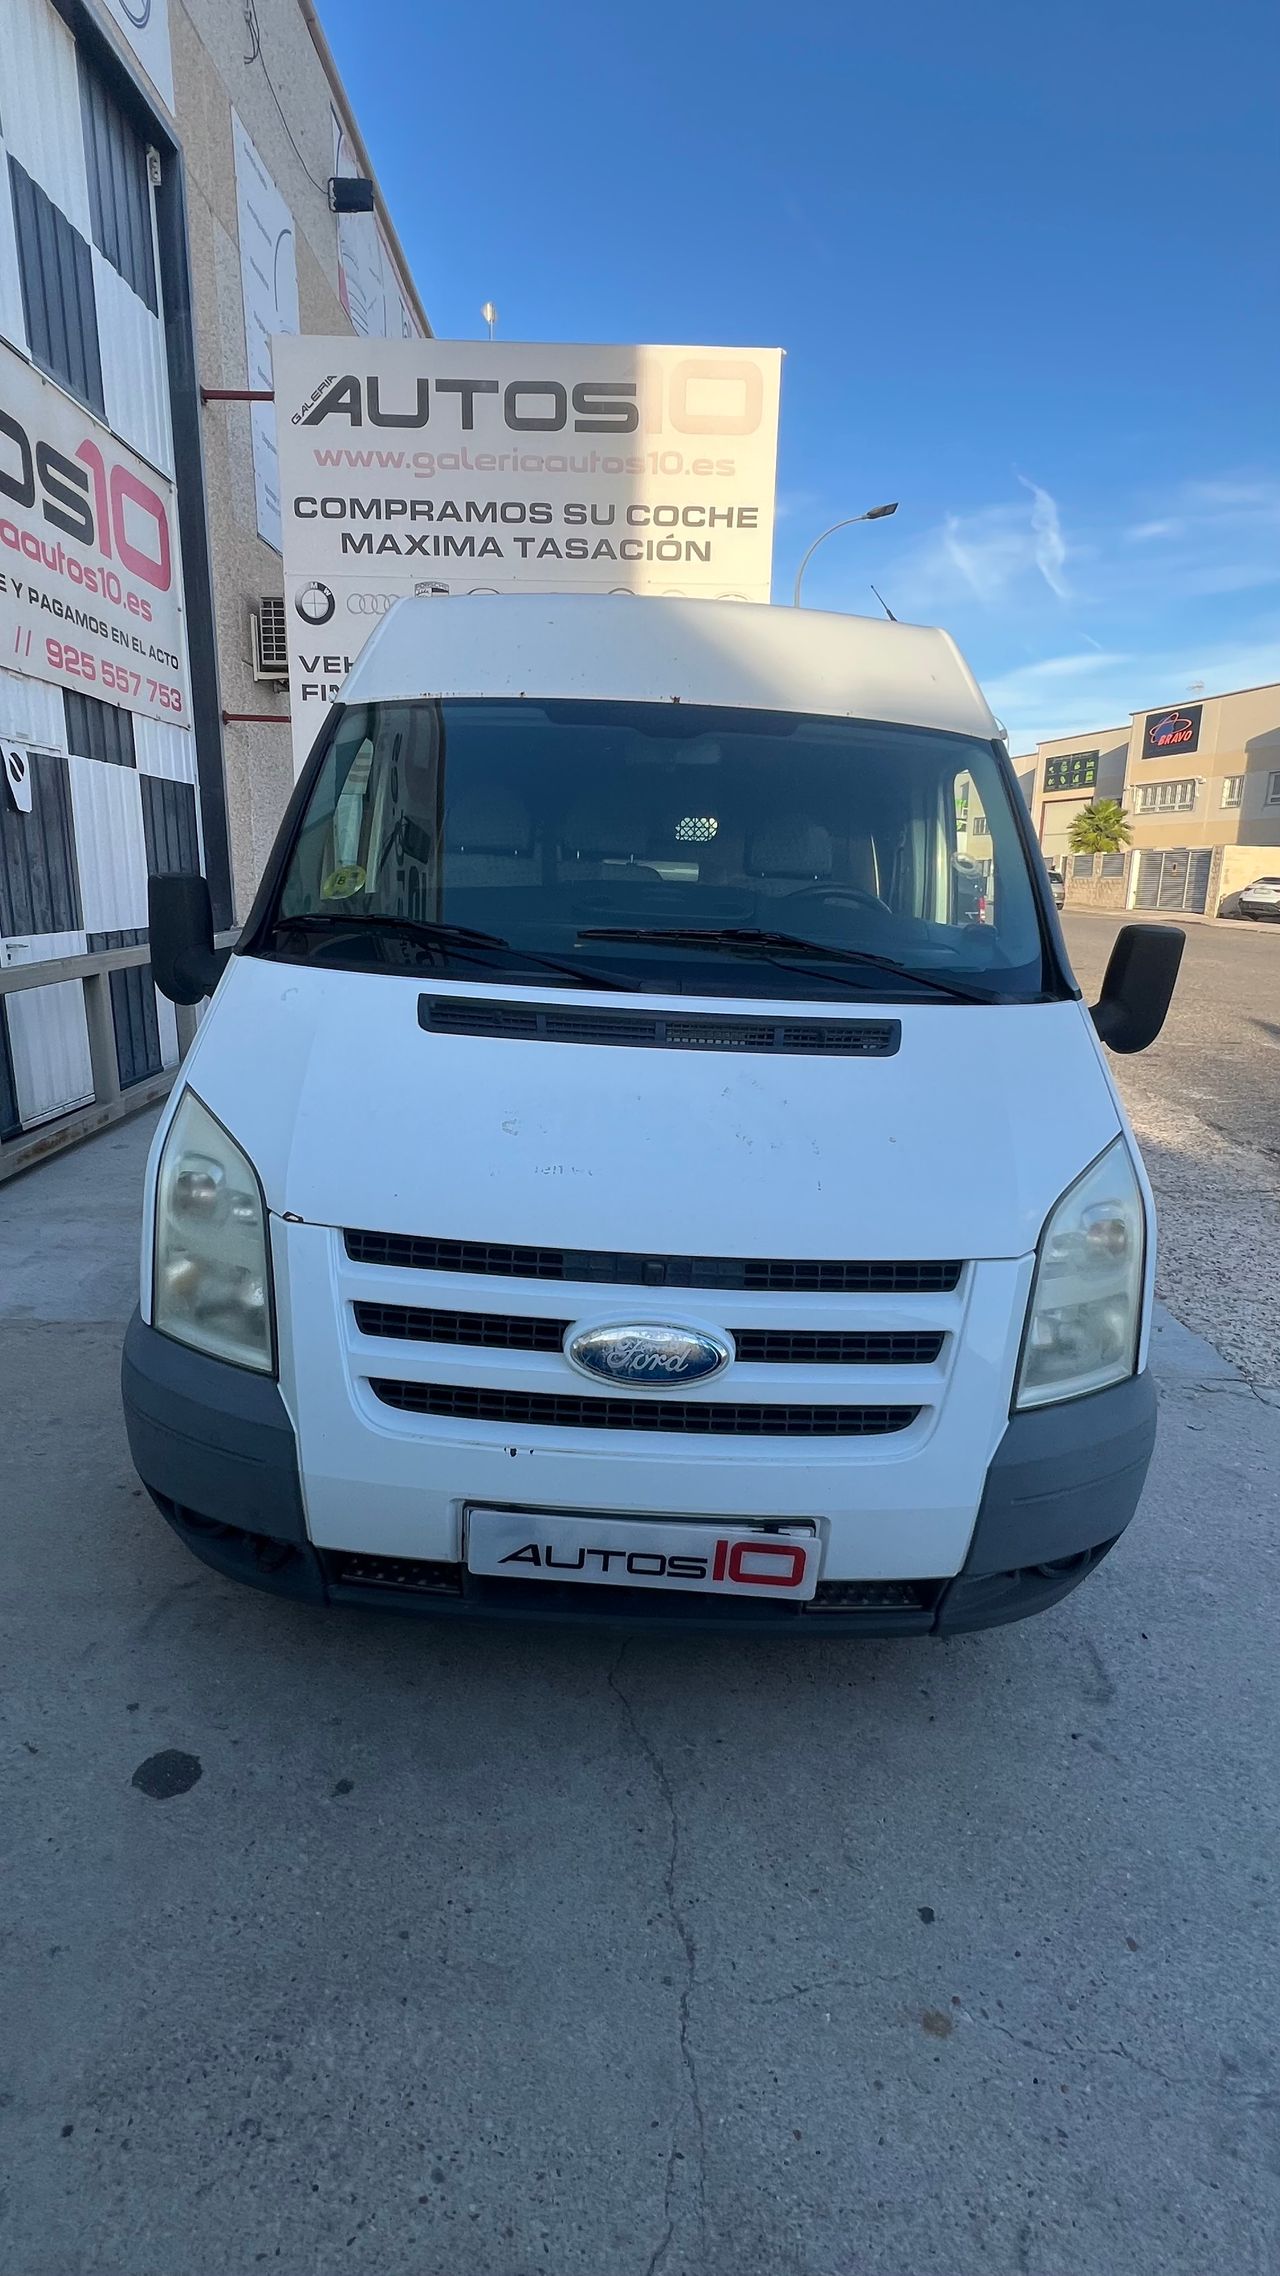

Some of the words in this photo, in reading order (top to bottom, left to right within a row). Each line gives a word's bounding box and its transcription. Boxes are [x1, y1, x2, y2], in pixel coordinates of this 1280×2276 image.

[291, 374, 337, 425] GALERIA
[301, 358, 764, 435] AUTOS10
[313, 447, 736, 479] www.galeriaautos10.es
[293, 497, 553, 525] COMPRAMOS
[563, 503, 615, 526] SU
[626, 505, 759, 528] COCHE
[341, 533, 504, 558] MAXIMA
[513, 533, 711, 562] TASACIÓN
[11, 578, 23, 599] Y
[28, 586, 108, 639] PAGAMOS
[112, 630, 130, 649] EN
[131, 636, 146, 657] EL
[149, 645, 179, 670] ACTO
[45, 638, 96, 681] 925
[101, 659, 141, 697] 557
[147, 679, 182, 712] 753
[1157, 730, 1193, 746] BRAVO
[606, 1336, 689, 1373] Ford
[497, 1539, 807, 1588] AUTOS10
